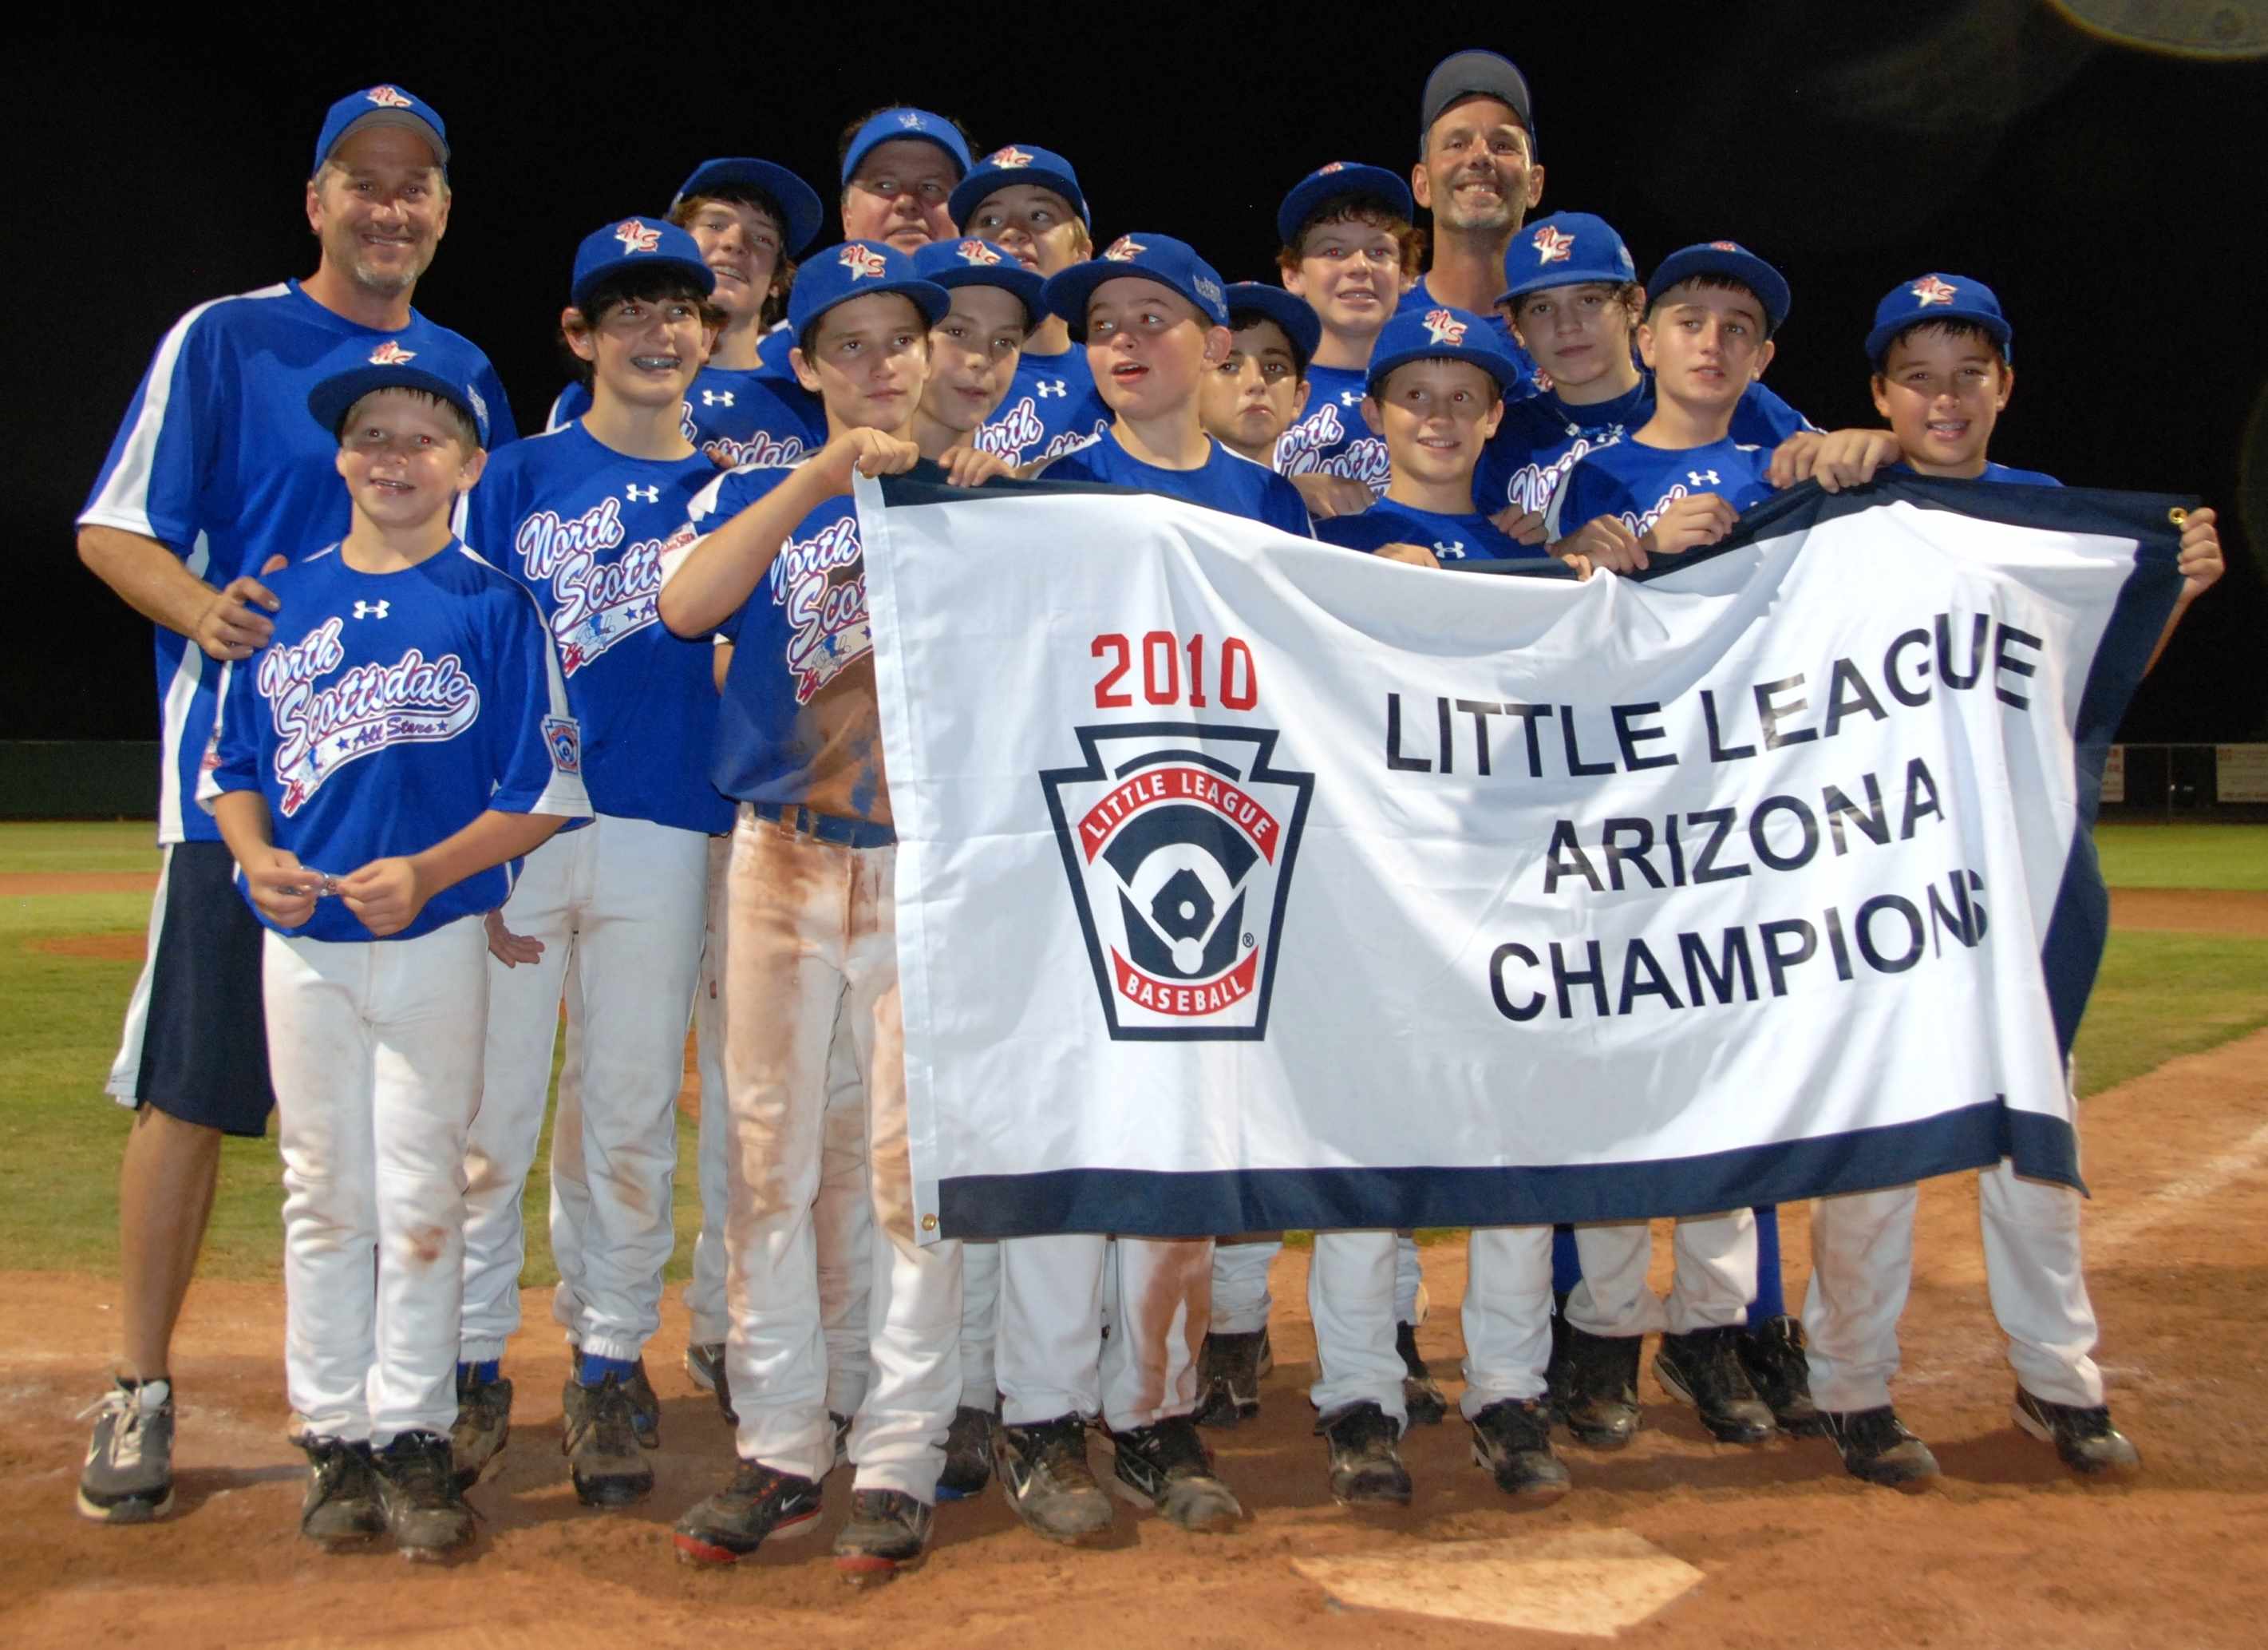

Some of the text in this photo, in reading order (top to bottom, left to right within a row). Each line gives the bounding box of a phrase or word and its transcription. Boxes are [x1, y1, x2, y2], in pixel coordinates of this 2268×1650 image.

[974, 398, 1044, 461] orth
[1273, 404, 1345, 476] orth
[516, 497, 625, 581] North
[1091, 631, 1258, 711] 2010
[1386, 612, 2043, 778] LITTLE LEAGUE
[1085, 772, 1271, 841] LITTLE LEAGUE
[1543, 757, 1946, 894] ARIZONA
[1125, 974, 1245, 1013] BASEBALL
